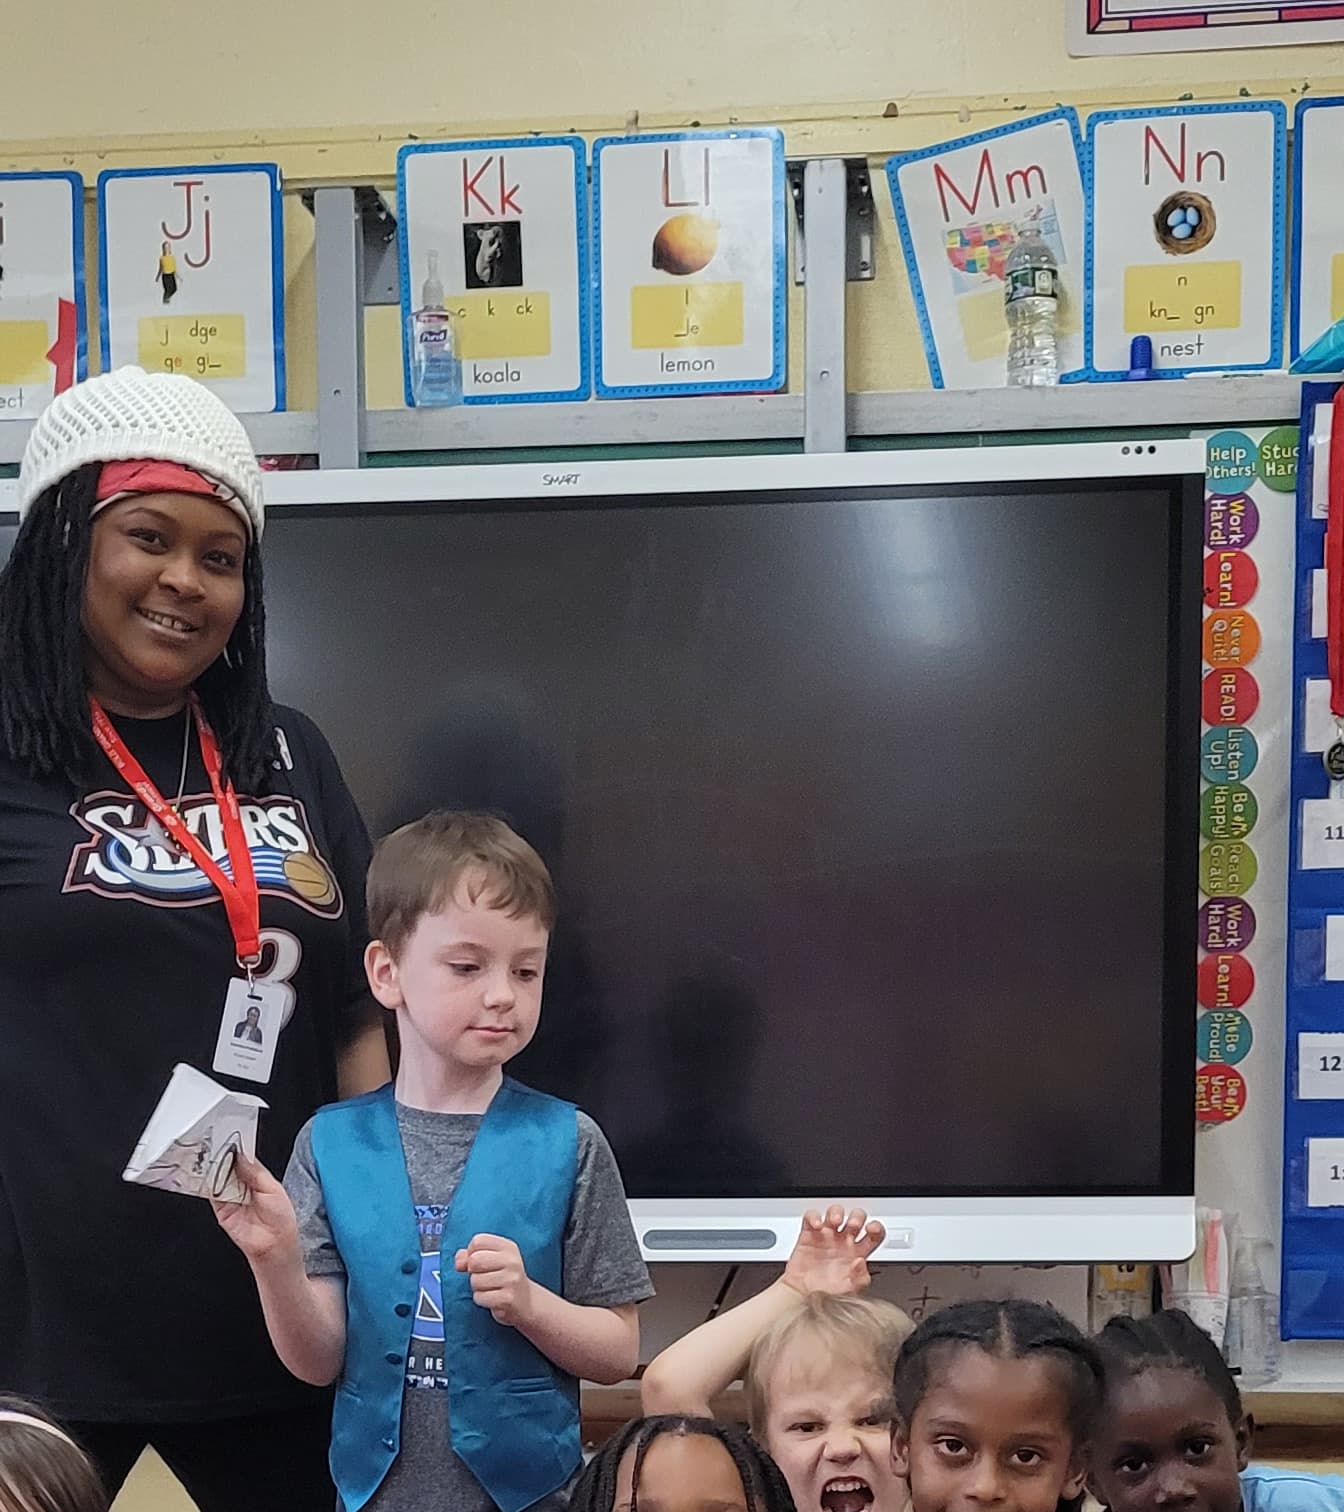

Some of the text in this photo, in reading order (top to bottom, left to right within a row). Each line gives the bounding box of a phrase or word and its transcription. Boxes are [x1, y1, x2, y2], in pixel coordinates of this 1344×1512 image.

[664, 147, 709, 207] Ll
[1145, 123, 1225, 185] Nn
[463, 156, 522, 217] Kk
[933, 148, 1047, 222] Mm
[161, 181, 210, 268] Jj
[660, 353, 715, 374] lemon
[1161, 336, 1205, 357] nest
[474, 362, 520, 385] koala
[1211, 447, 1246, 463] Help
[542, 473, 581, 486] SMART
[1209, 499, 1228, 545] Hard!
[1230, 499, 1246, 544] Work
[1219, 552, 1236, 606] Learn!
[1220, 674, 1236, 721] READ!
[1204, 741, 1225, 770] Up!
[1228, 728, 1245, 780] Listen
[1209, 785, 1229, 838] Happy!
